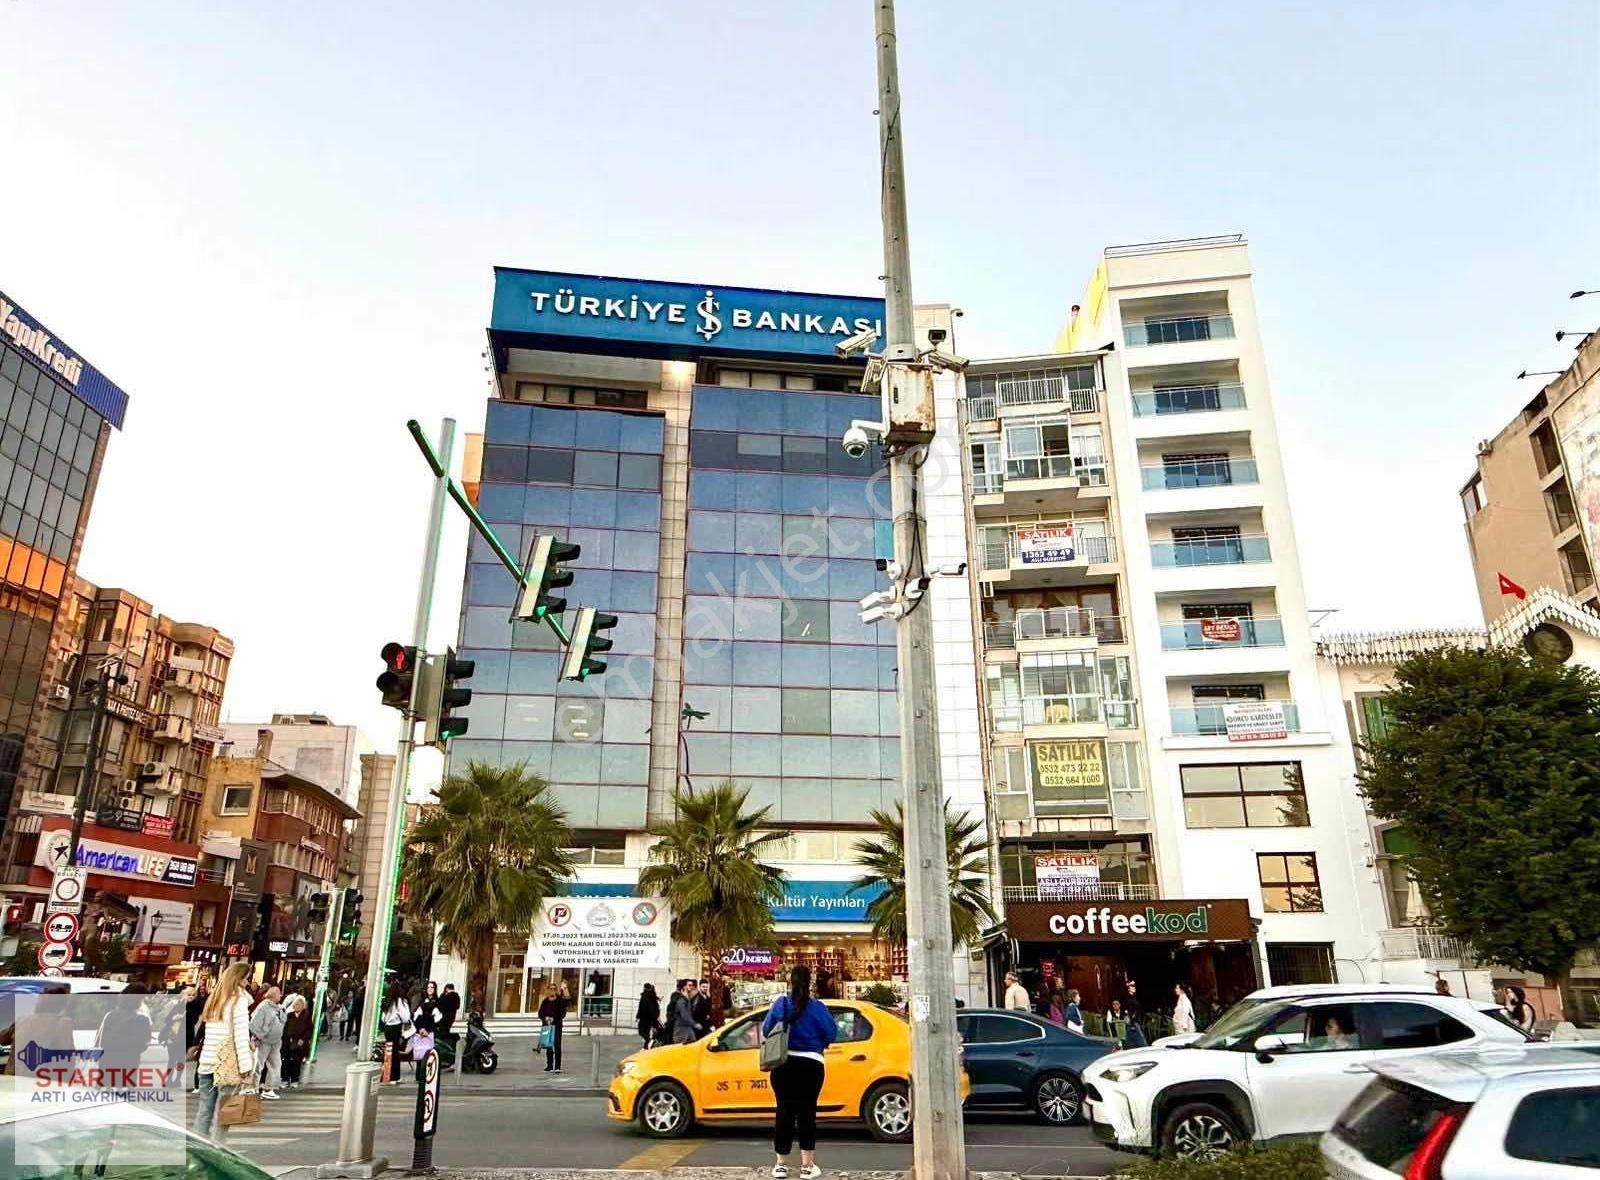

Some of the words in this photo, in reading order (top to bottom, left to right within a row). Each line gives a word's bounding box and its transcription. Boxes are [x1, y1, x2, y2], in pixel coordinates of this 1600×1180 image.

[530, 287, 687, 324] TÜRKİYE
[732, 308, 883, 338] BANKASI
[1038, 743, 1097, 762] SATILIK
[1044, 776, 1064, 786] 0532
[75, 844, 138, 873] American
[810, 896, 865, 911] Yayınları
[1049, 906, 1207, 934] coffeekod
